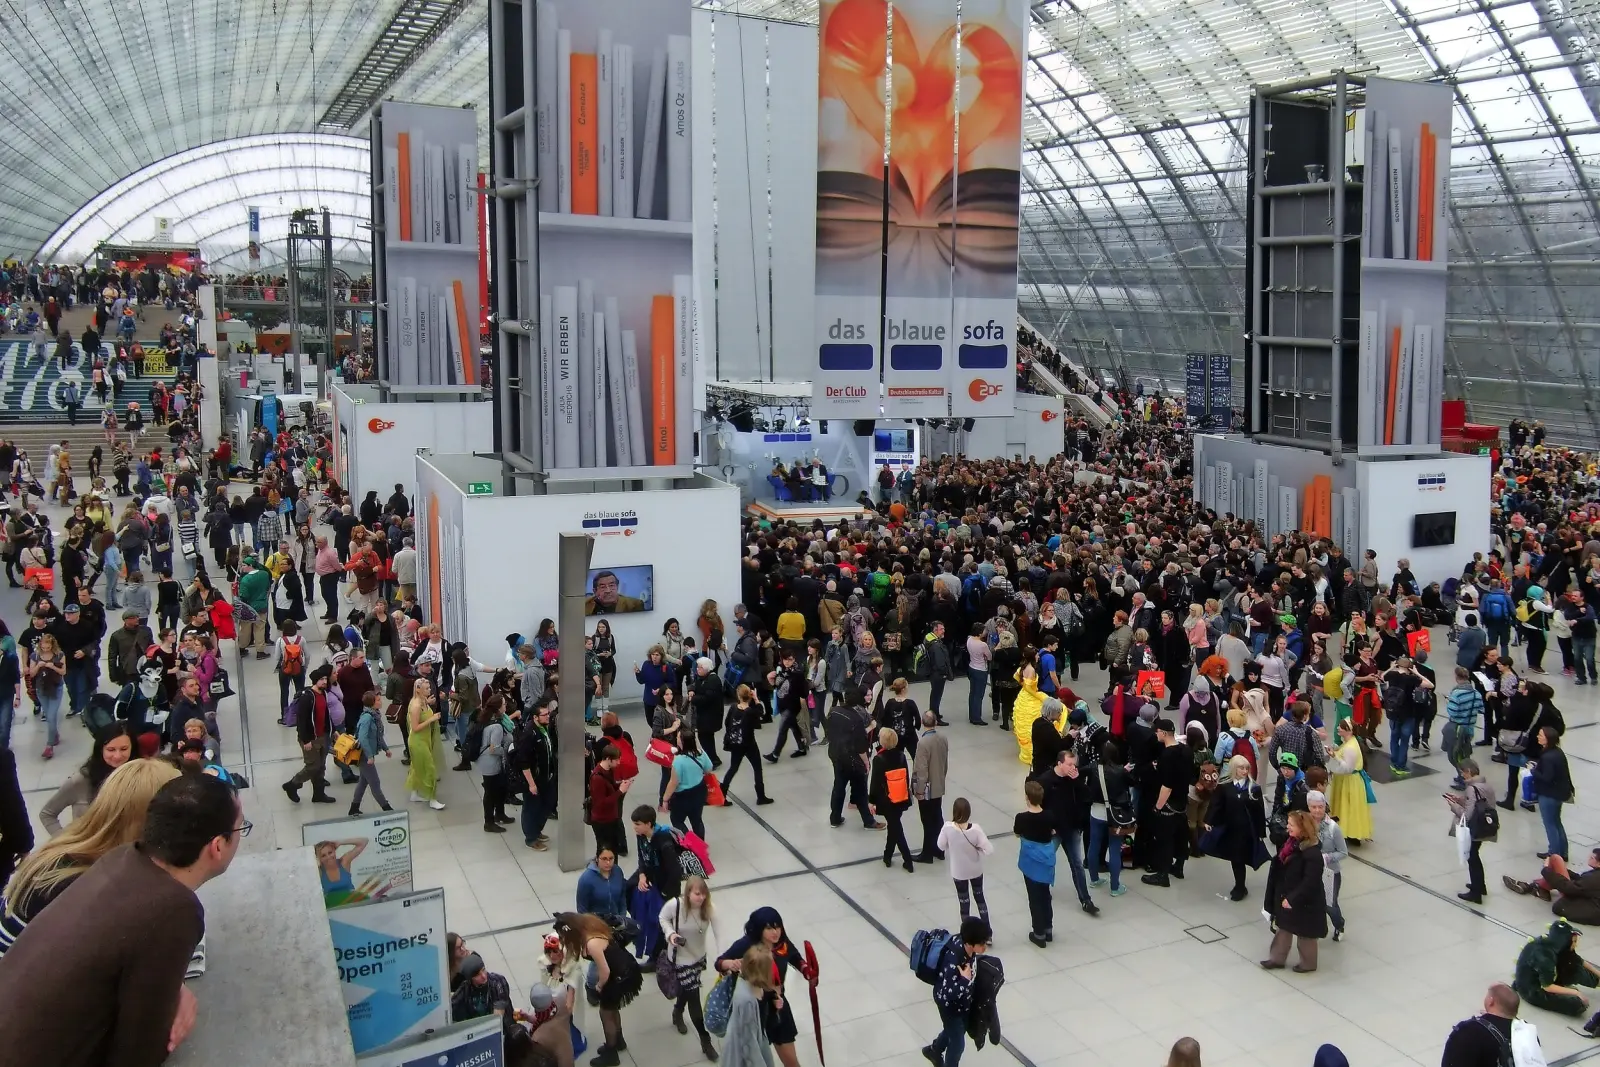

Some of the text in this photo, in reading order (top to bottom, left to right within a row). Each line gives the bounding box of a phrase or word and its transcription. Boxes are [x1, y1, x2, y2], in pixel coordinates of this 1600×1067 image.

[676, 93, 684, 106] Oz
[676, 109, 685, 137] Amos
[402, 318, 413, 346] 89/90
[828, 318, 1004, 340] das blaue sofa
[559, 316, 569, 380] WIR ERBEN
[827, 386, 866, 396] Der Club
[375, 833, 402, 842] therapie
[338, 962, 383, 983] Open
[400, 973, 411, 982] 23
[401, 982, 412, 991] 24
[402, 986, 432, 1000] 25 Okt
[417, 994, 439, 1006] 2015
